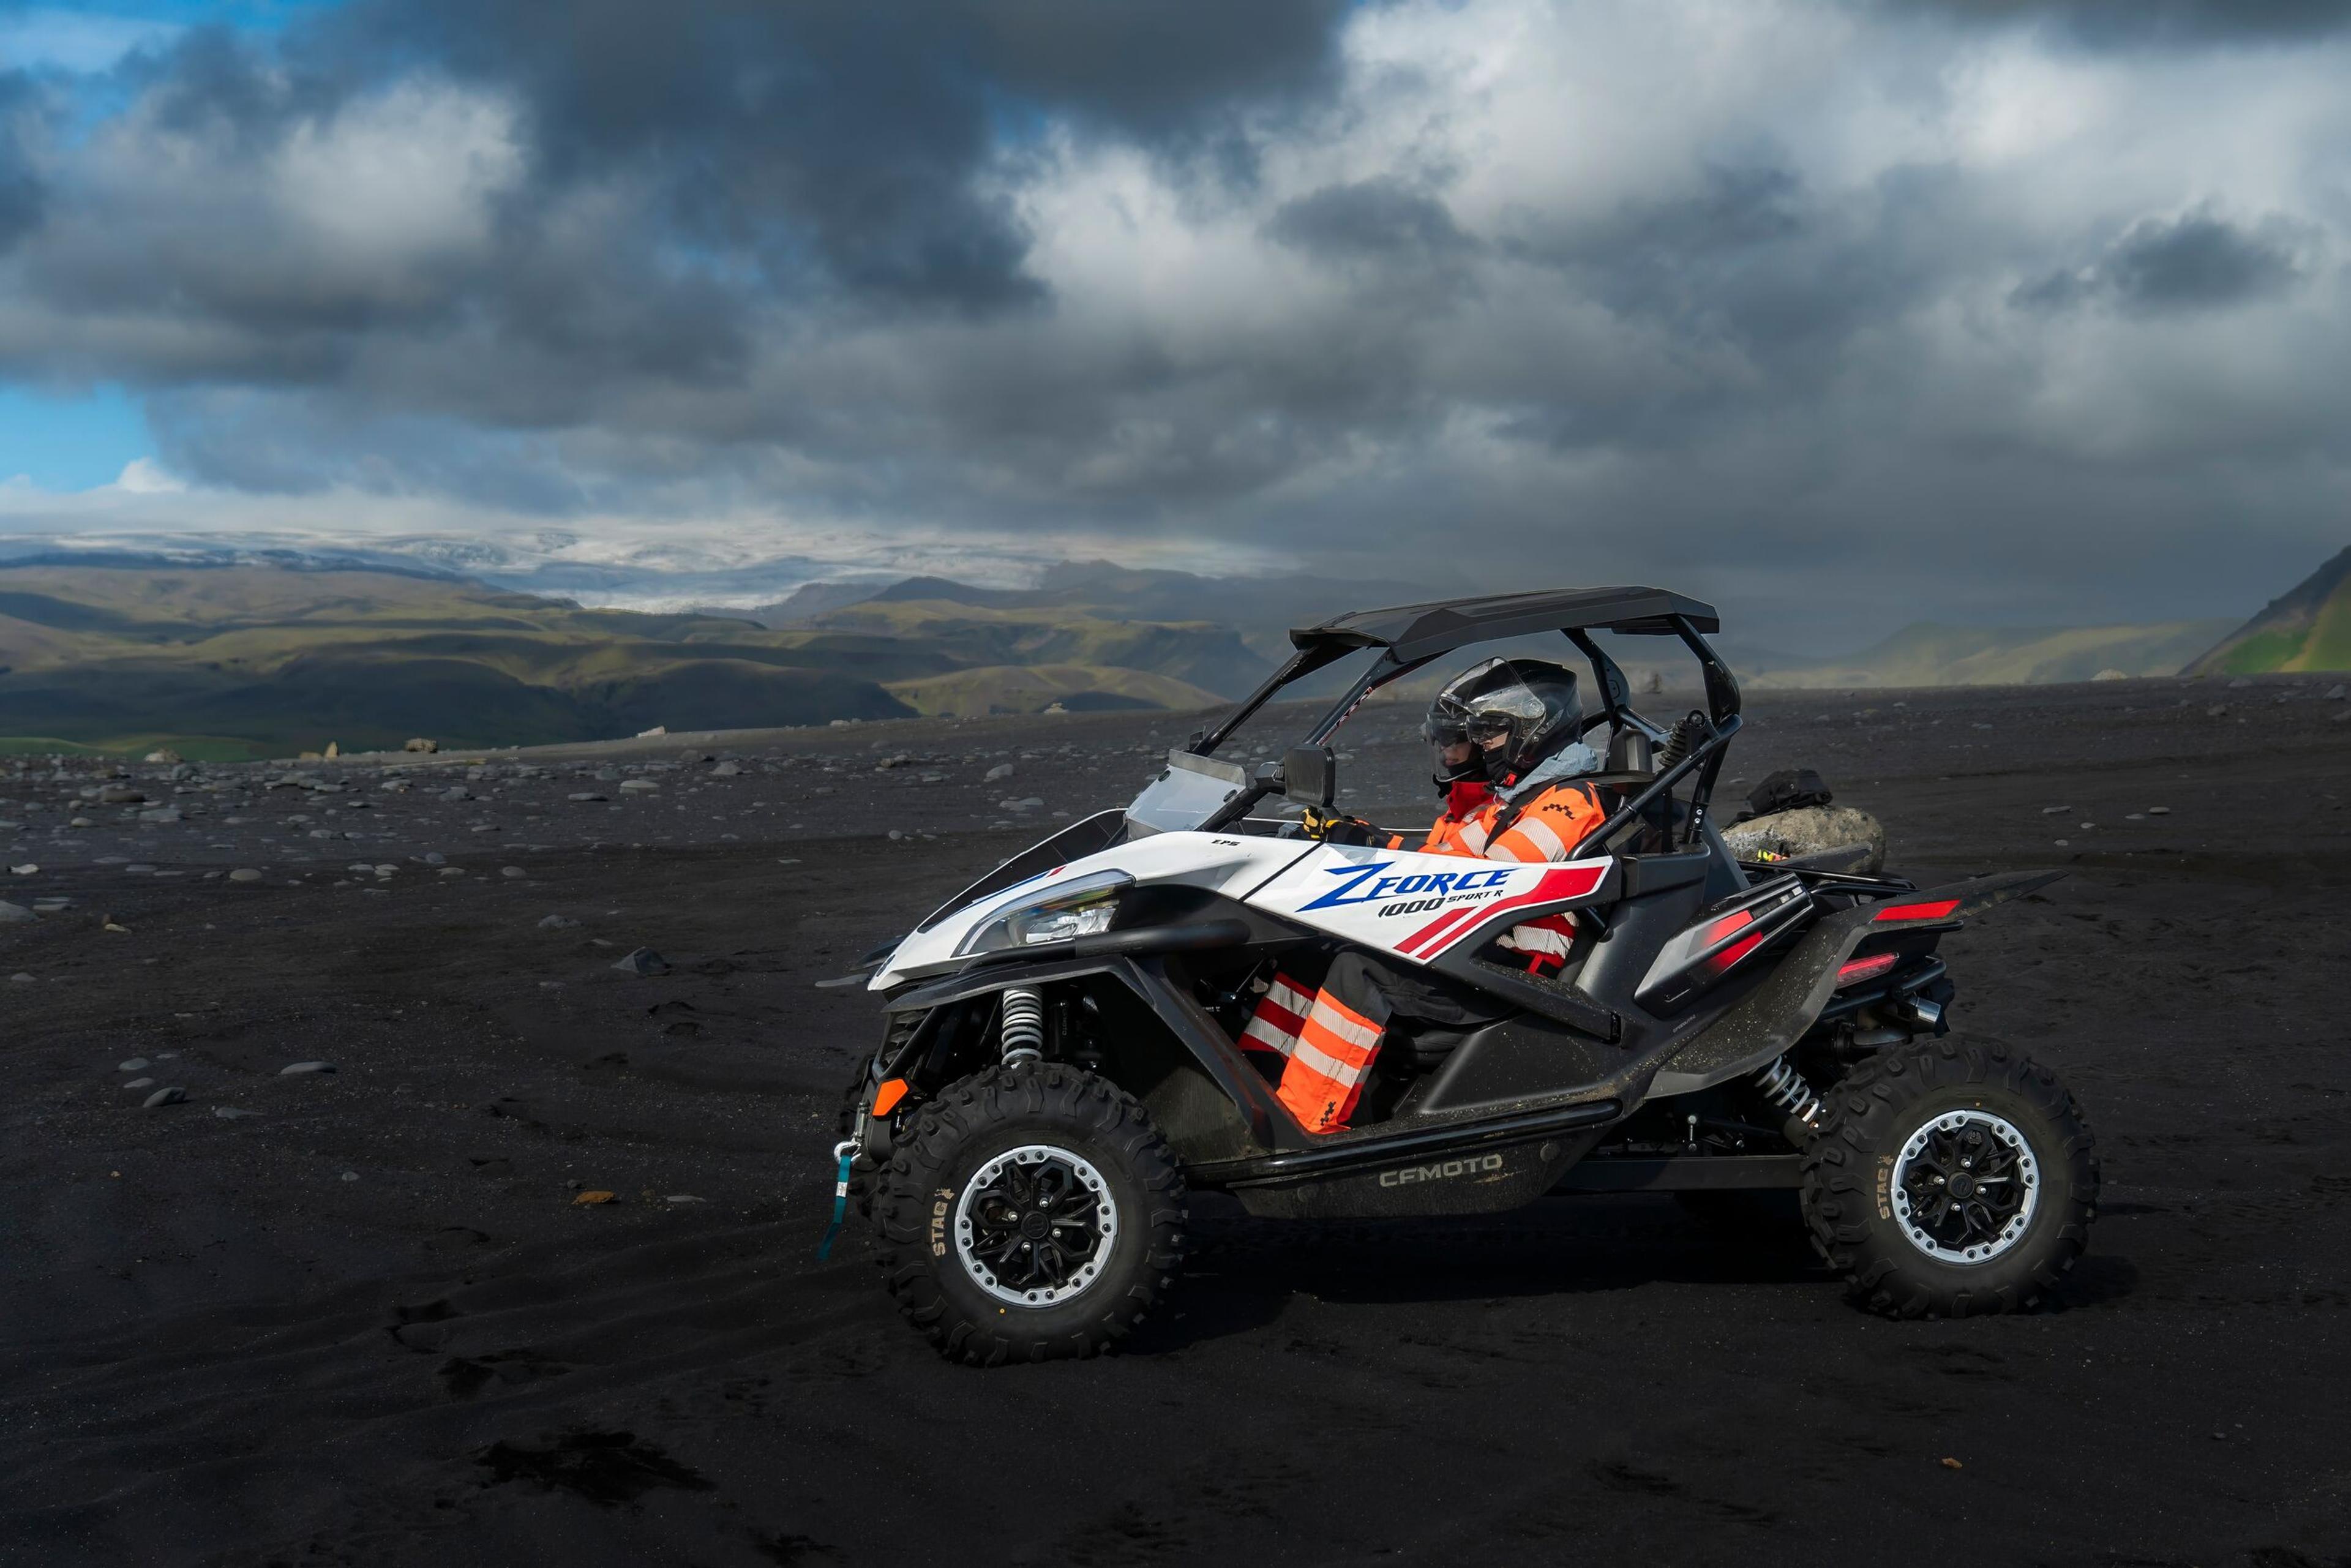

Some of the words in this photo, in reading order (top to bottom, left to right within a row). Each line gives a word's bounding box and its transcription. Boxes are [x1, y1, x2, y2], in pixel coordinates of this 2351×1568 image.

[1378, 898, 1445, 918] 1000
[1447, 891, 1491, 903] SPORT
[1379, 1153, 1503, 1187] CFMOTO
[1877, 1168, 1891, 1220] STAG
[931, 1201, 948, 1256] STAG
